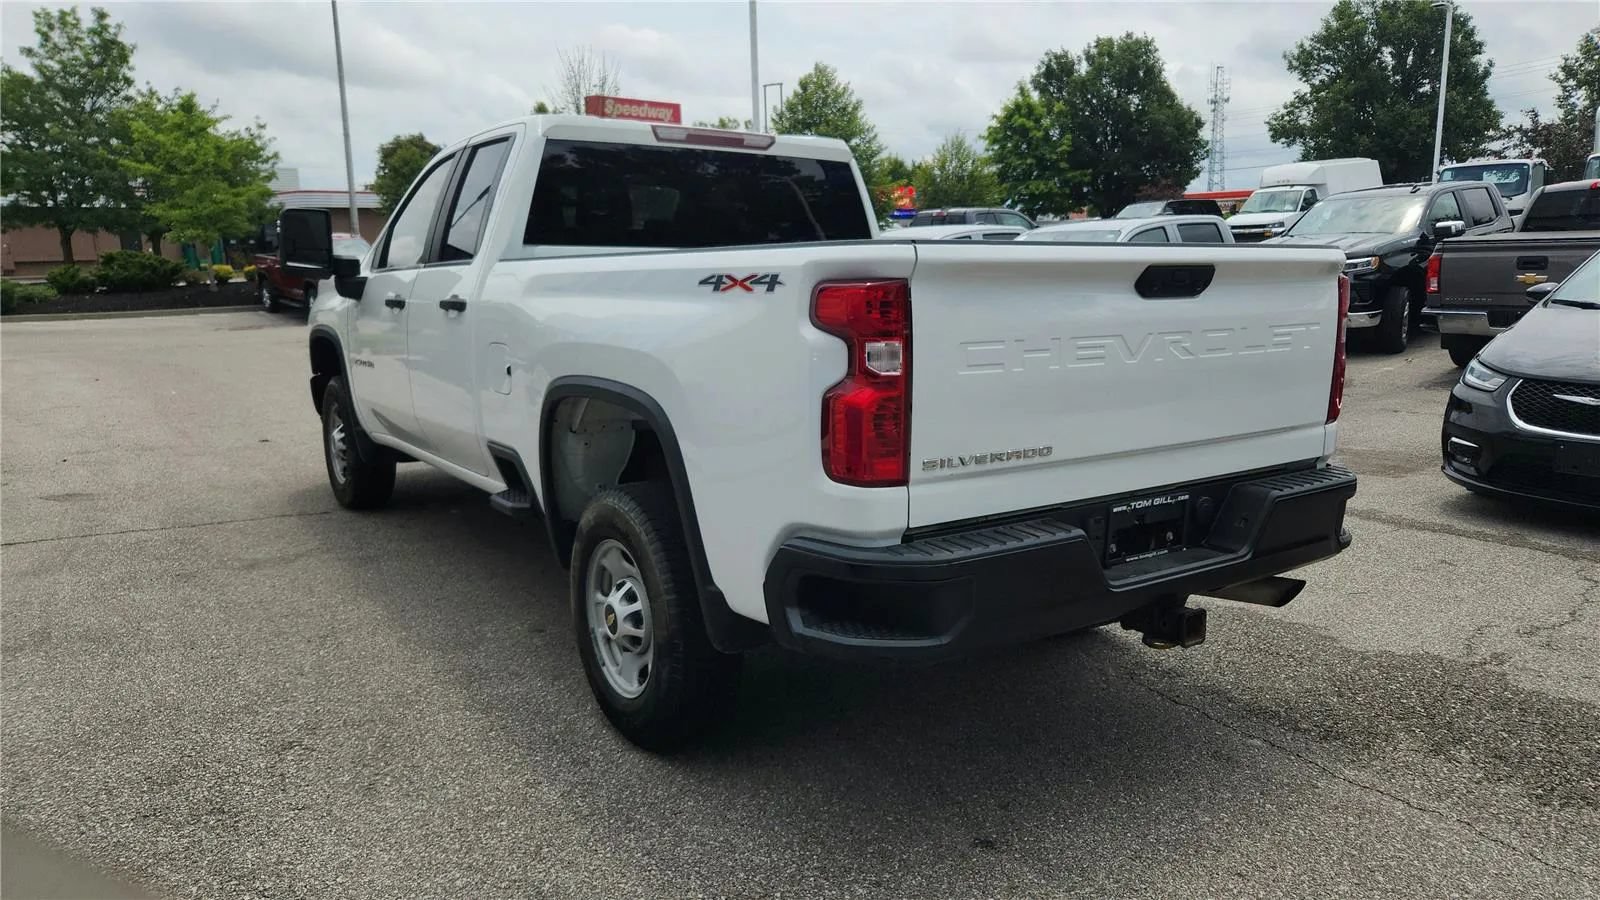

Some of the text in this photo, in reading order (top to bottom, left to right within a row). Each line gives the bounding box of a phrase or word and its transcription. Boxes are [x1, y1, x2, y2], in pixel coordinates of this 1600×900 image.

[604, 99, 672, 121] Speedway
[958, 322, 1320, 375] CHEVROLET
[922, 446, 1053, 472] SILVERADO
[1130, 499, 1152, 510] TOM
